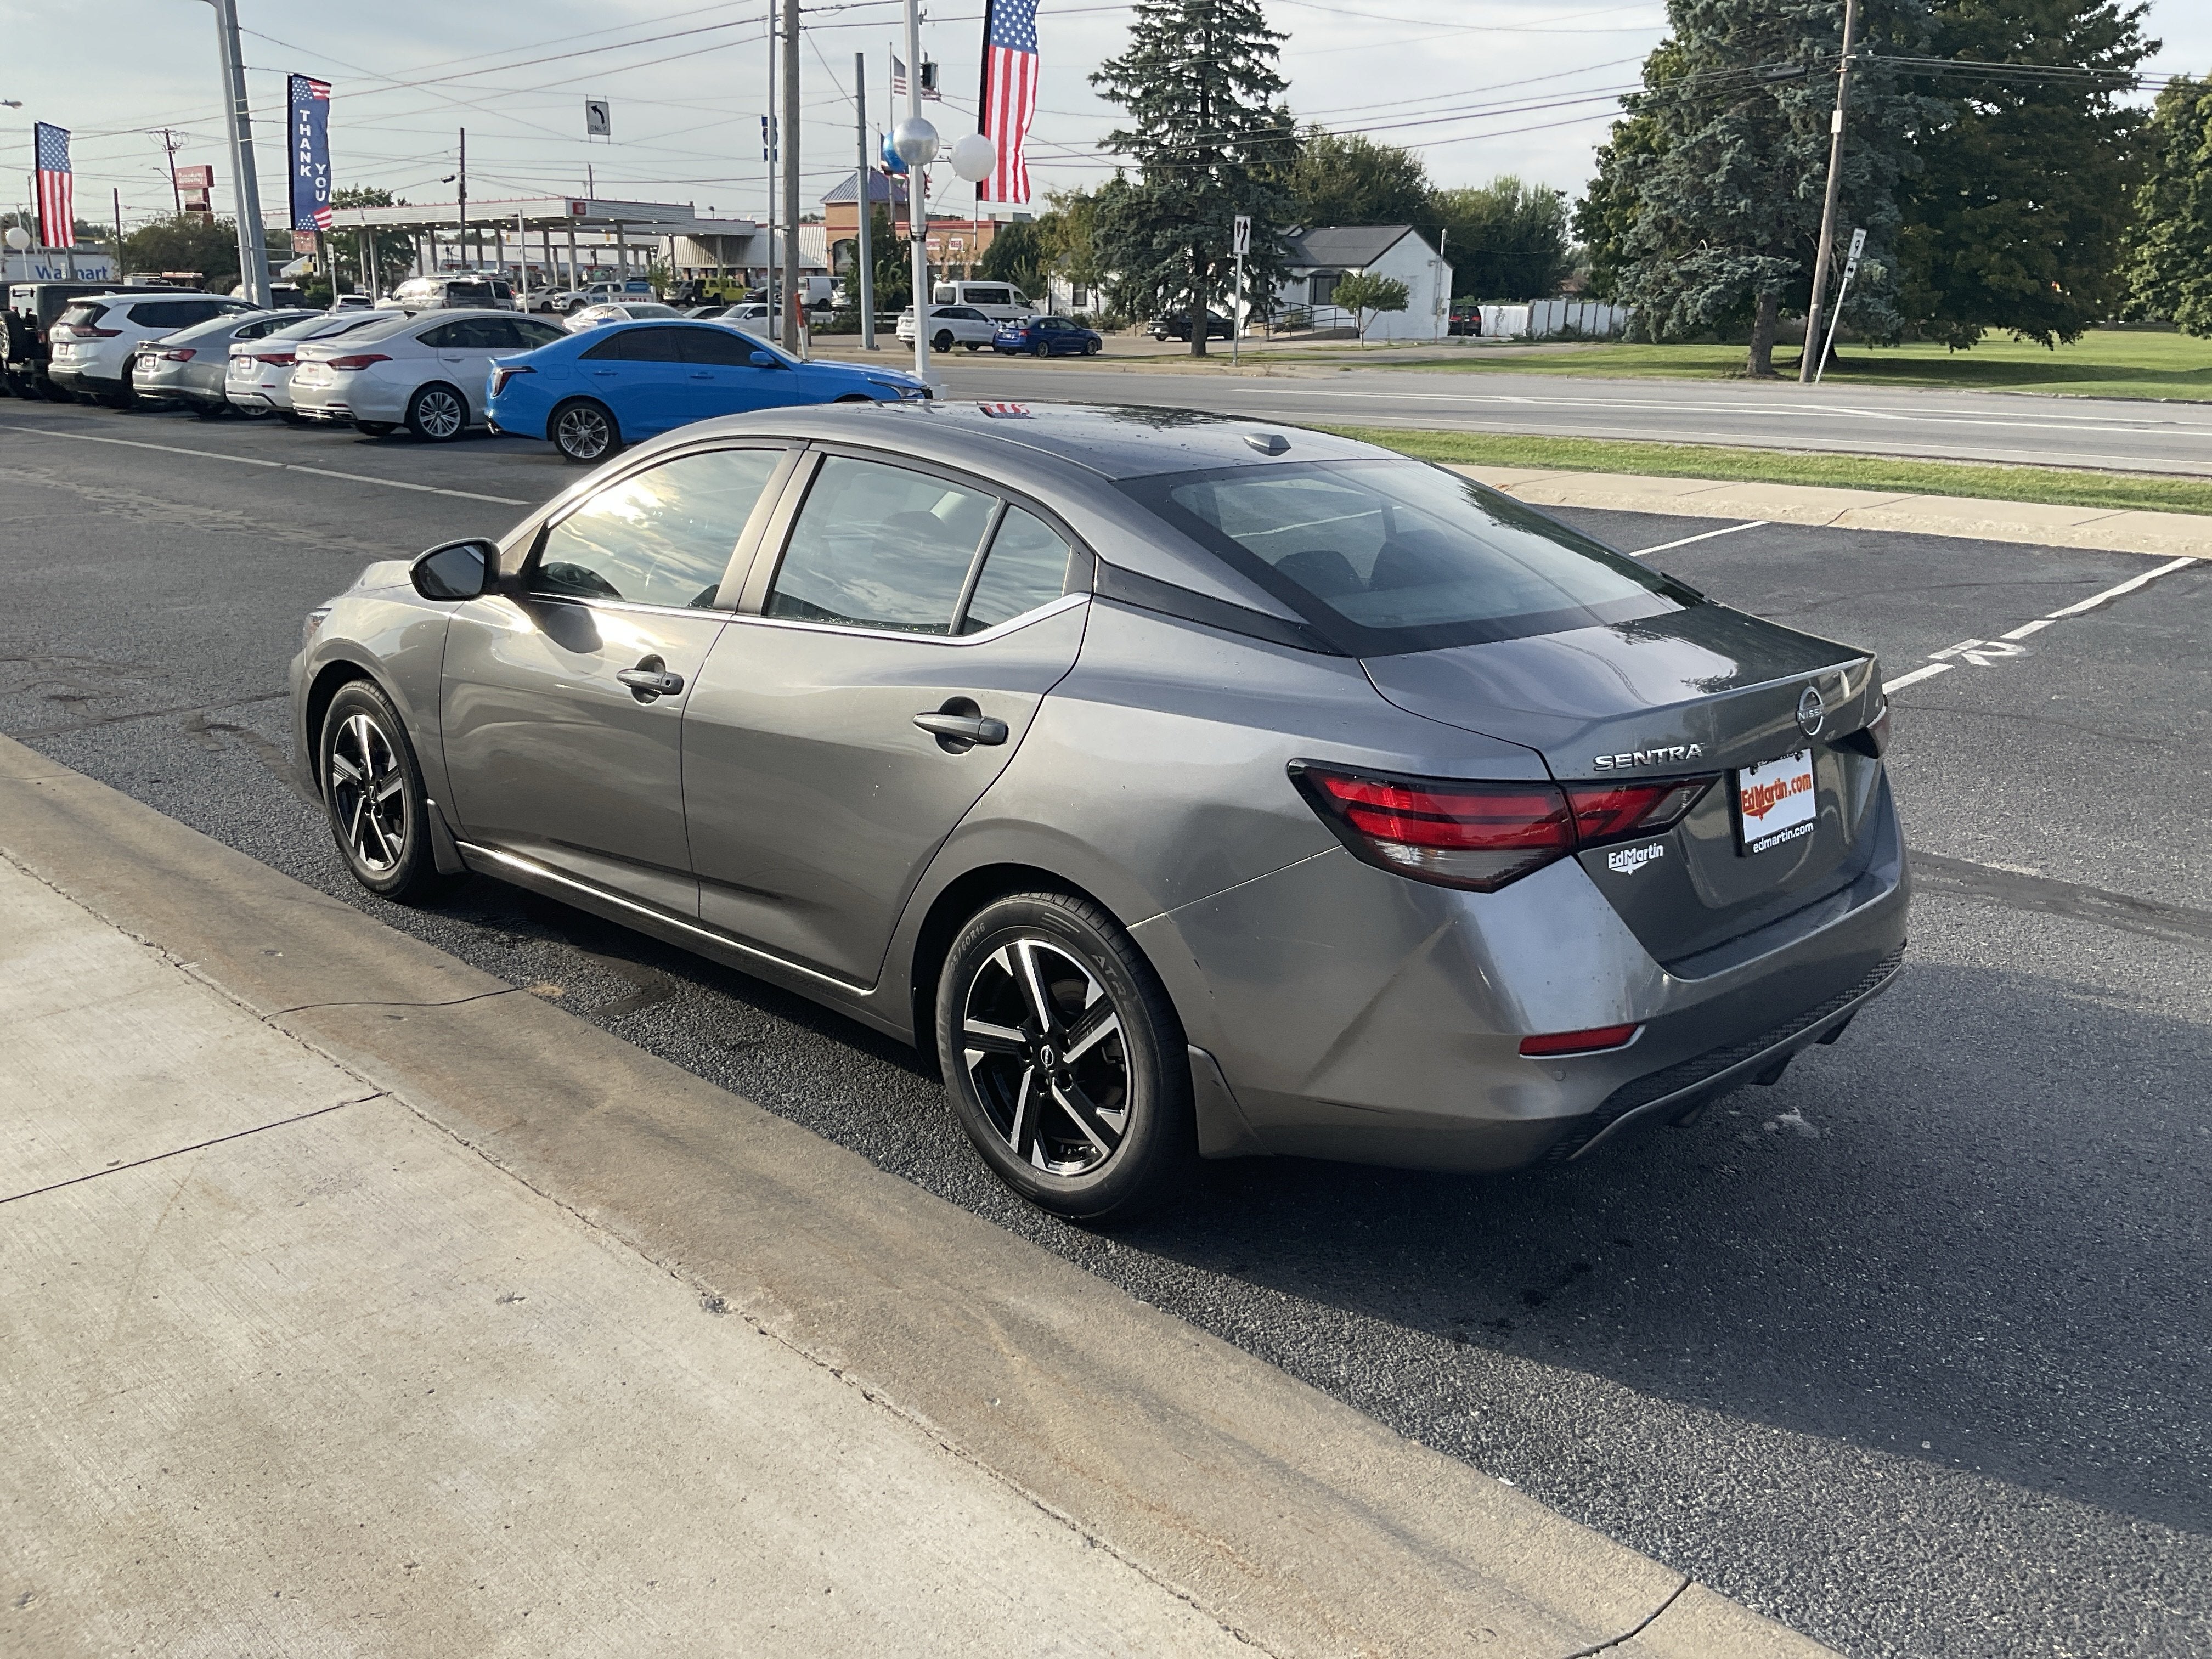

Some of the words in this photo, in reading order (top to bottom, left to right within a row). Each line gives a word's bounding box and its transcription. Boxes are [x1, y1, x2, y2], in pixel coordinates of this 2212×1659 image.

[299, 109, 312, 177] THANK
[315, 163, 327, 201] YOU
[1594, 743, 1703, 771] SENTRA
[1740, 773, 1812, 810] EdMartin.com
[1753, 822, 1814, 854] edmartin.com
